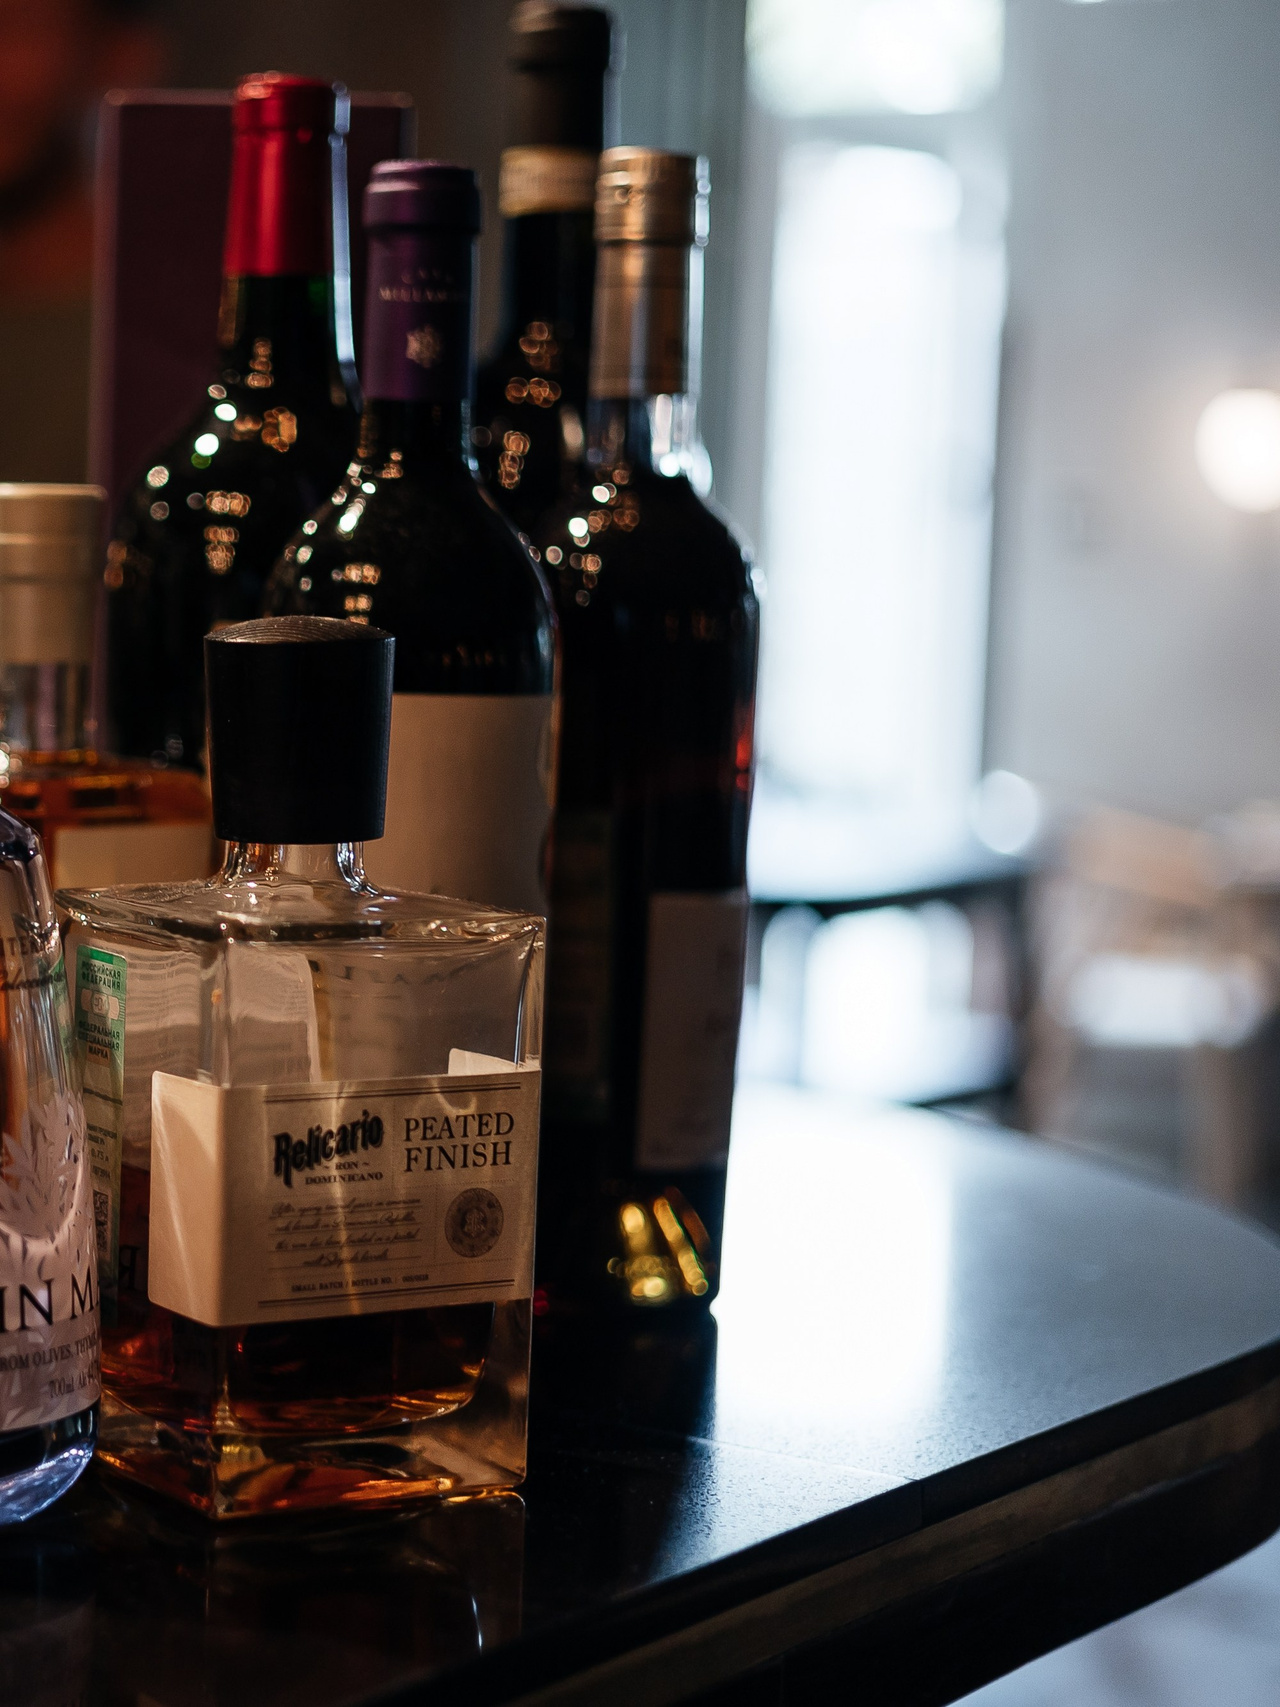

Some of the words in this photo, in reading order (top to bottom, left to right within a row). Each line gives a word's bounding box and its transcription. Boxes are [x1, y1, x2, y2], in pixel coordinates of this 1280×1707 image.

[82, 961, 121, 980] РОССИЙСКАЯ
[82, 971, 121, 990] ФЕДЕРАЦИЯ
[404, 1112, 516, 1142] PEATED
[273, 1110, 385, 1188] Relicario
[404, 1140, 513, 1173] FINISH
[335, 1161, 359, 1171] RON
[305, 1171, 383, 1186] DOMINICANO
[70, 1265, 99, 1321] M
[291, 1284, 316, 1293] SMALL
[319, 1280, 343, 1291] BATCH
